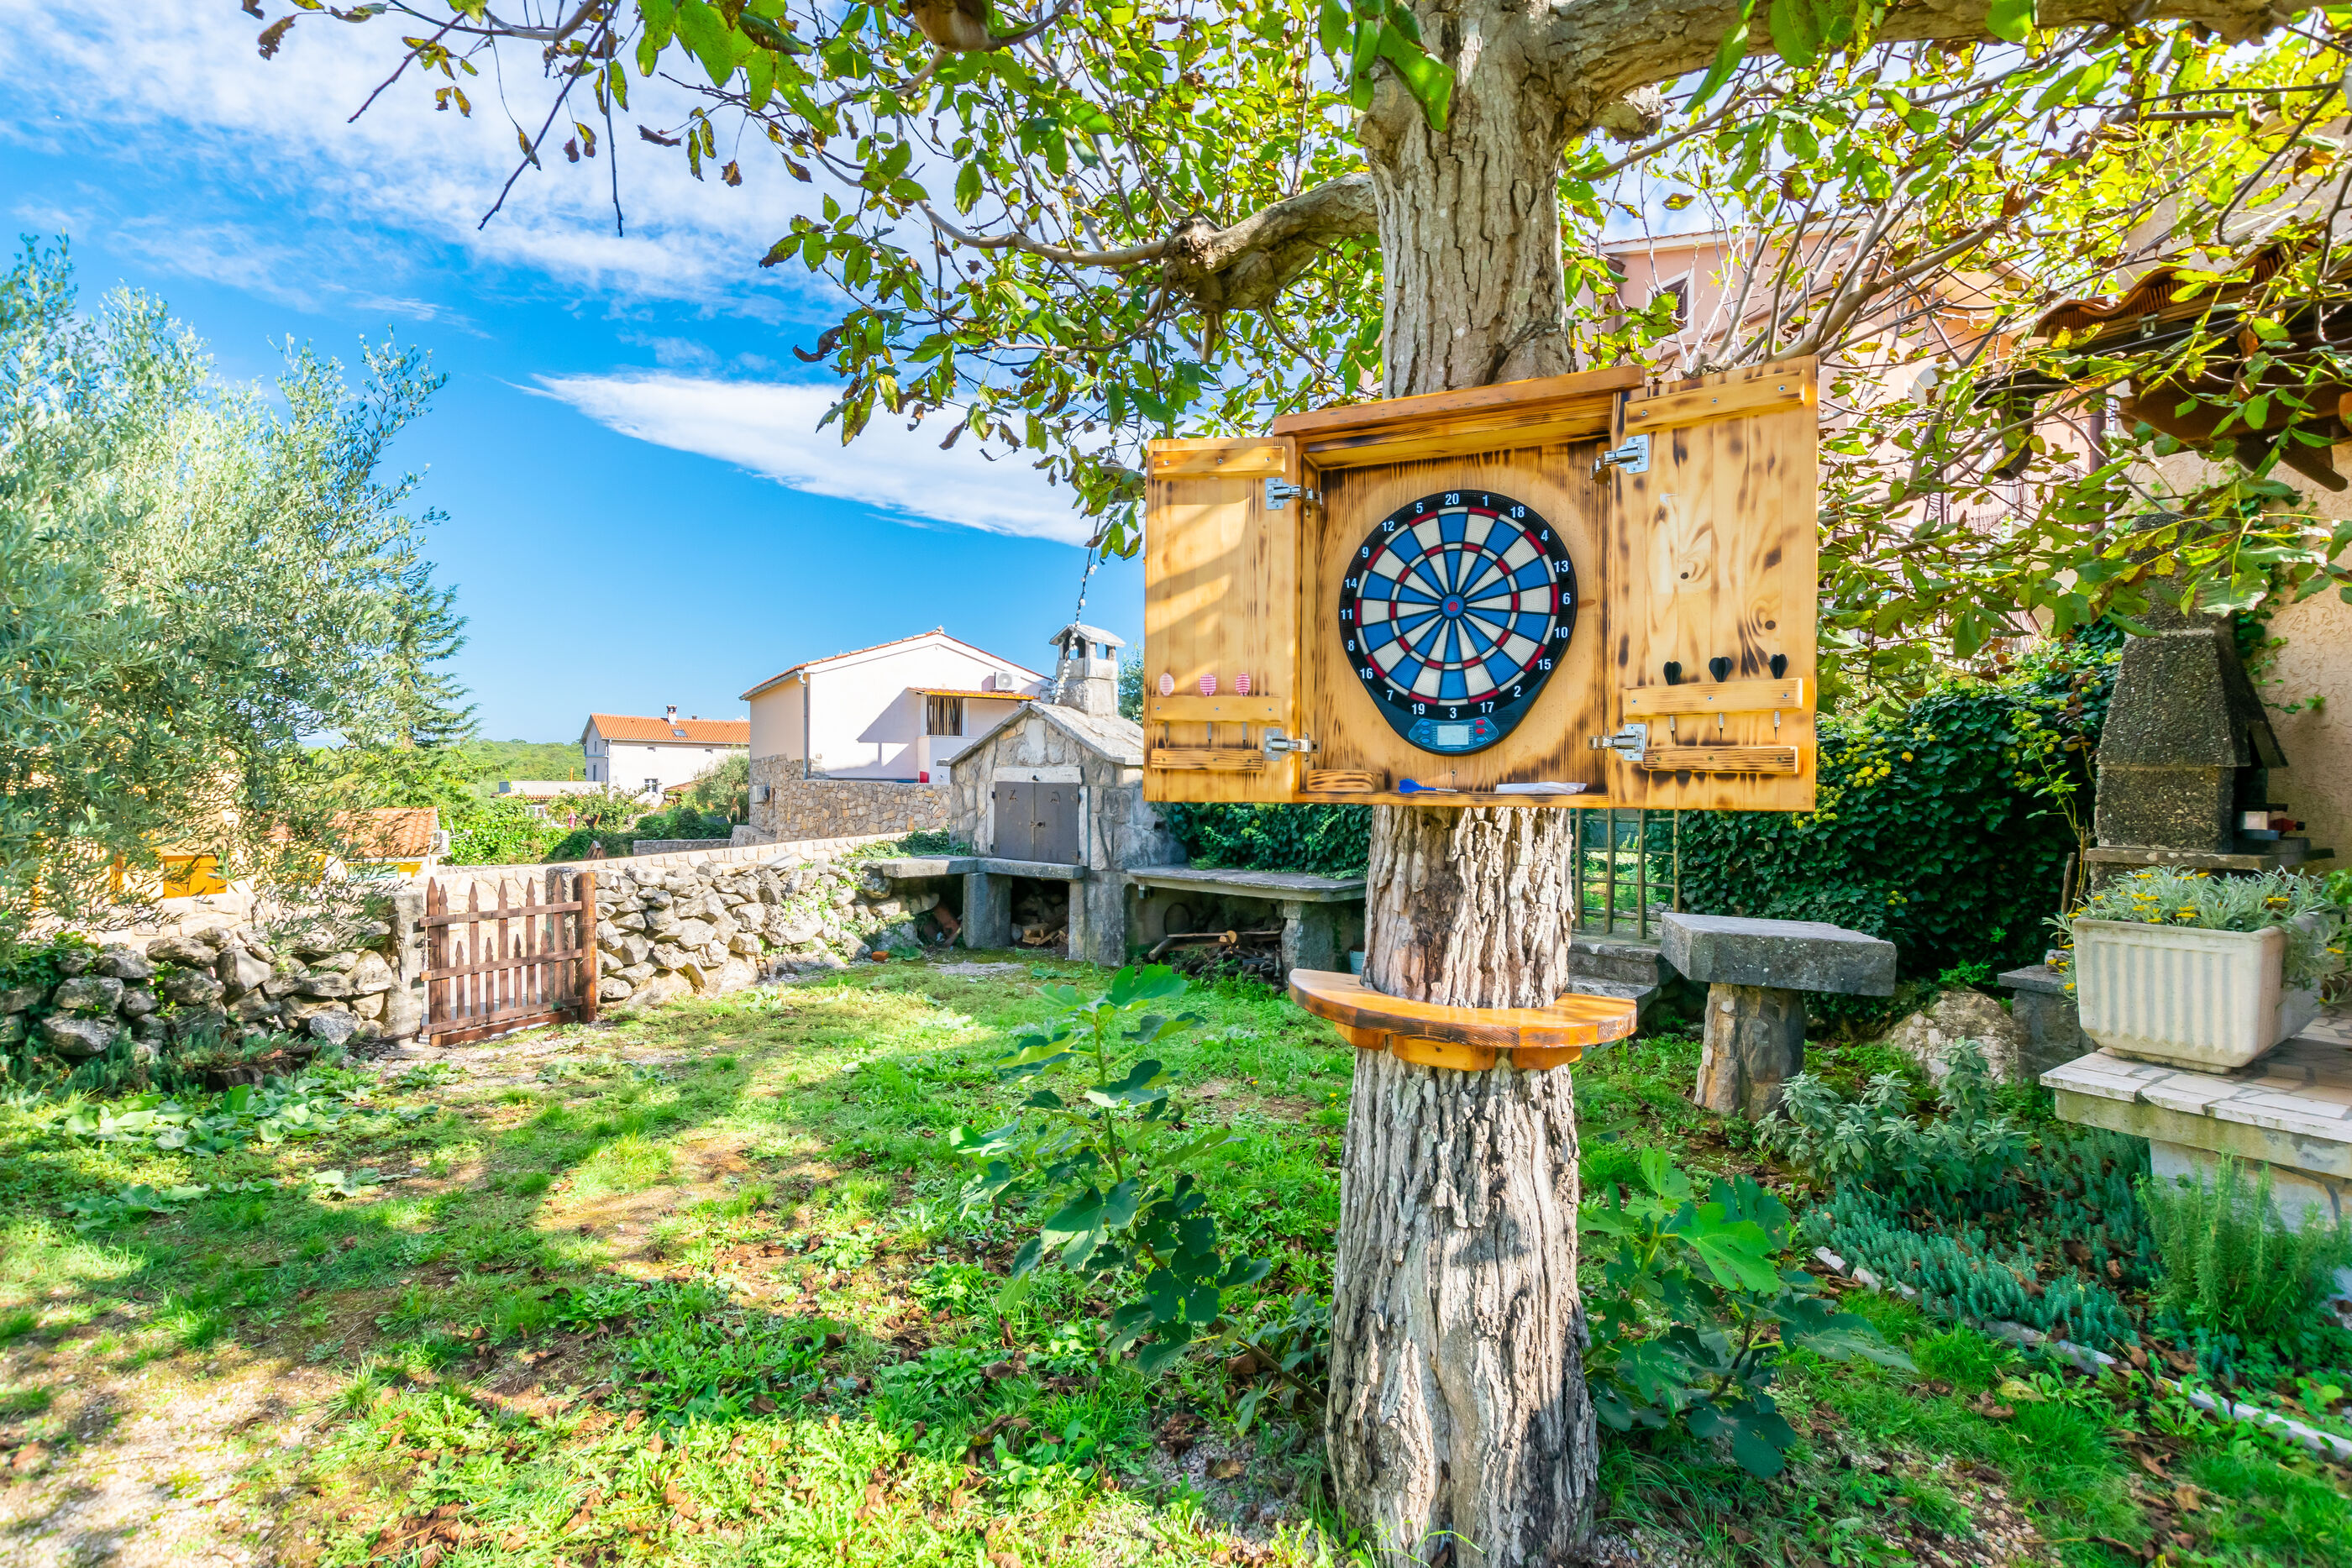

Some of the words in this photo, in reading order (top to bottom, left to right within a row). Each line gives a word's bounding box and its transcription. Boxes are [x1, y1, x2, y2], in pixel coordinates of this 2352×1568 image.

[1446, 494, 1458, 505] 20
[1483, 495, 1488, 506] 1
[1416, 502, 1422, 513] 5
[1510, 506, 1524, 517] 18
[1382, 522, 1394, 532] 12
[1541, 530, 1548, 541] 4
[1362, 547, 1368, 558] 9
[1554, 560, 1568, 572] 13
[1344, 578, 1357, 589] 14
[1563, 593, 1570, 604] 6
[1341, 609, 1353, 620] 11
[1555, 627, 1567, 637] 10
[1348, 640, 1354, 651] 8
[1538, 659, 1551, 669] 15
[1360, 668, 1373, 679] 16
[1387, 690, 1393, 700] 7
[1515, 686, 1520, 697] 2
[1412, 704, 1425, 715] 19
[1450, 707, 1457, 718] 3
[1481, 702, 1494, 713] 17
